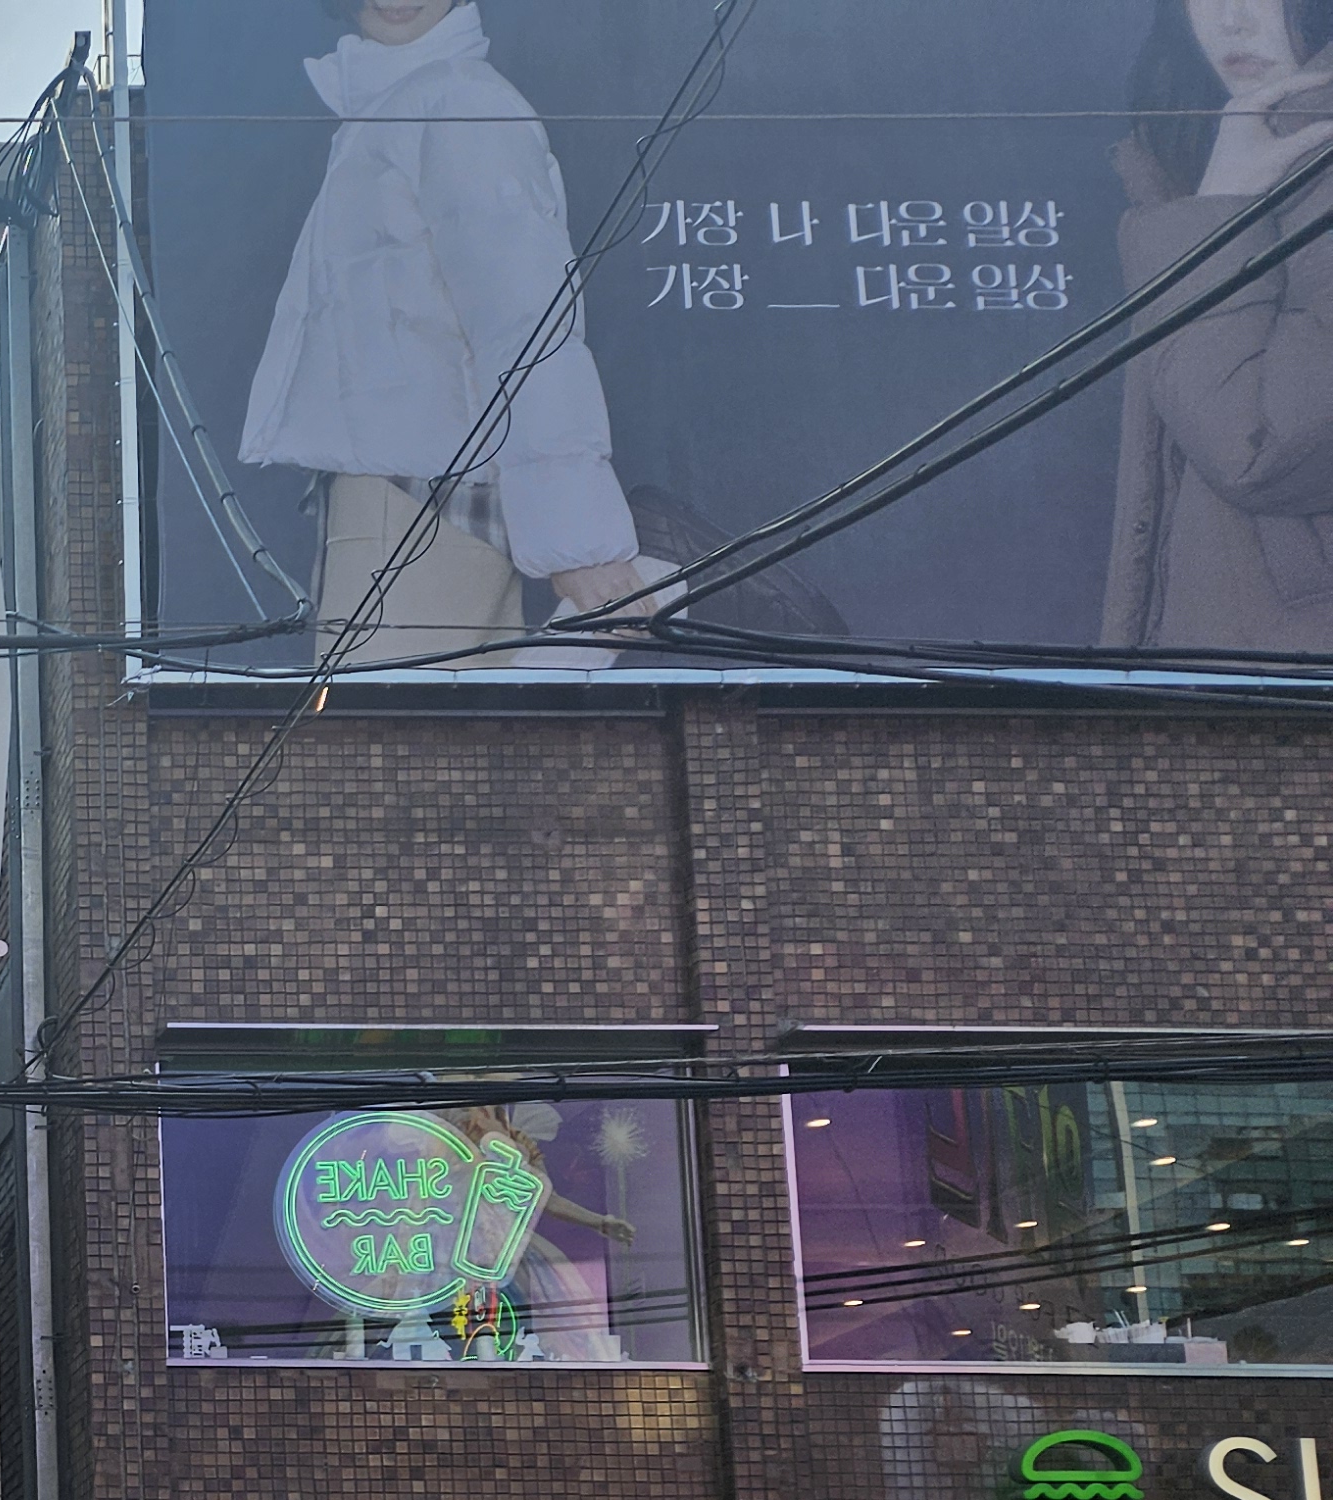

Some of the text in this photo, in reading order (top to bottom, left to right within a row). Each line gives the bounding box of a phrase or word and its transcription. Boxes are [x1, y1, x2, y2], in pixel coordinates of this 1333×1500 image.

[641, 200, 1065, 248] 가장 나 다운 일상
[646, 263, 1074, 311] 가장 다운 일상
